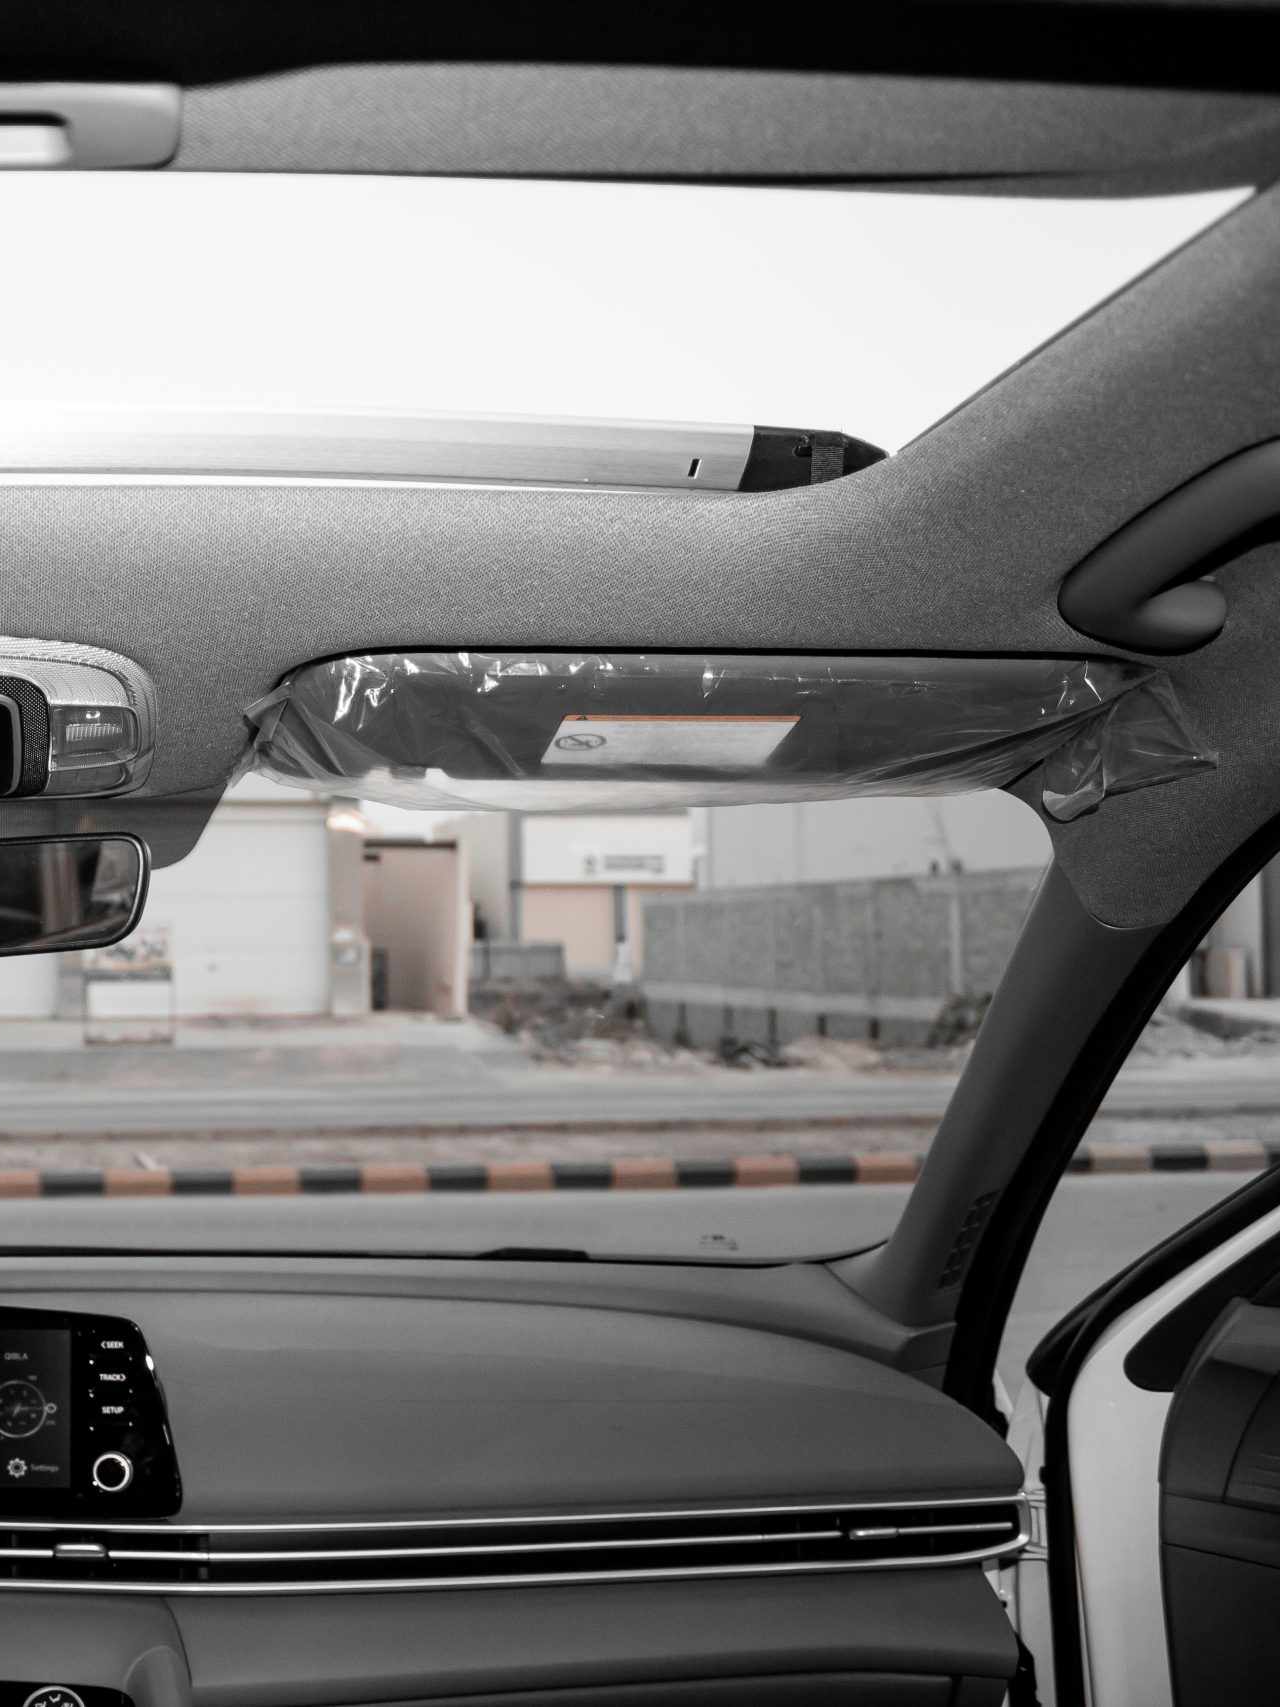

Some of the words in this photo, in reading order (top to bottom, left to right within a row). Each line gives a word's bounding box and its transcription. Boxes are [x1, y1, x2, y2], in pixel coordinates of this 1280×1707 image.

[106, 1341, 124, 1349] SEEK
[3, 1351, 29, 1361] QIBLA
[99, 1373, 120, 1381] TRACK
[101, 1406, 124, 1414] SETUP
[30, 1463, 59, 1473] Settings
